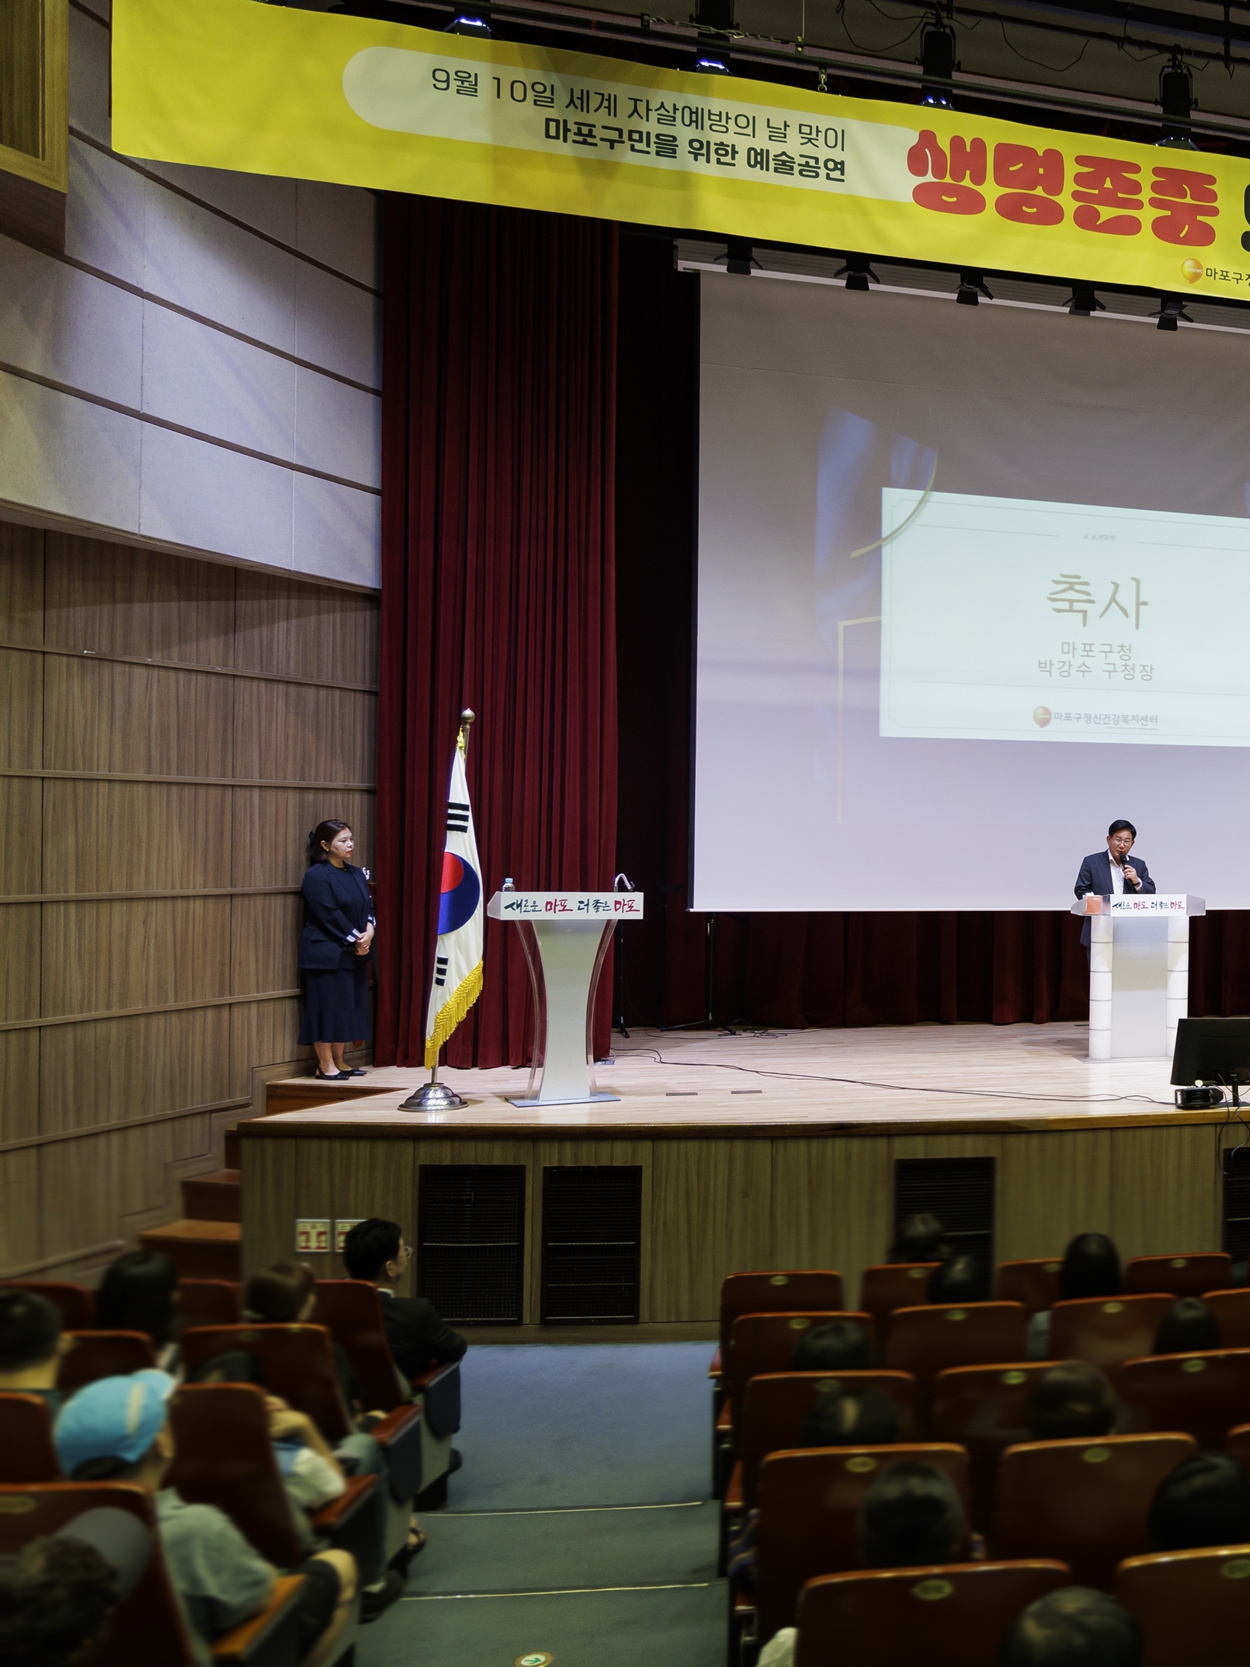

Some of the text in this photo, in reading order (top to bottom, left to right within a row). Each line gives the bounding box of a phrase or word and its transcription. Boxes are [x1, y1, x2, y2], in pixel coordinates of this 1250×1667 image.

[431, 67, 480, 97] 9월
[565, 86, 619, 119] 세계
[627, 96, 757, 138] 자살예방의
[765, 118, 791, 142] 날
[798, 123, 846, 152] 맞이
[544, 117, 847, 183] 마포구민을 위한 예술공연
[907, 129, 1219, 247] 생명존중
[1046, 573, 1149, 630] 축사
[1038, 659, 1155, 682] 박강수 구청장
[1061, 641, 1133, 662] 마포구청
[1054, 712, 1158, 727] 마포구정신건강복지센터
[504, 899, 542, 913] 새로운
[545, 899, 573, 914] 마포
[614, 899, 640, 913] 마포
